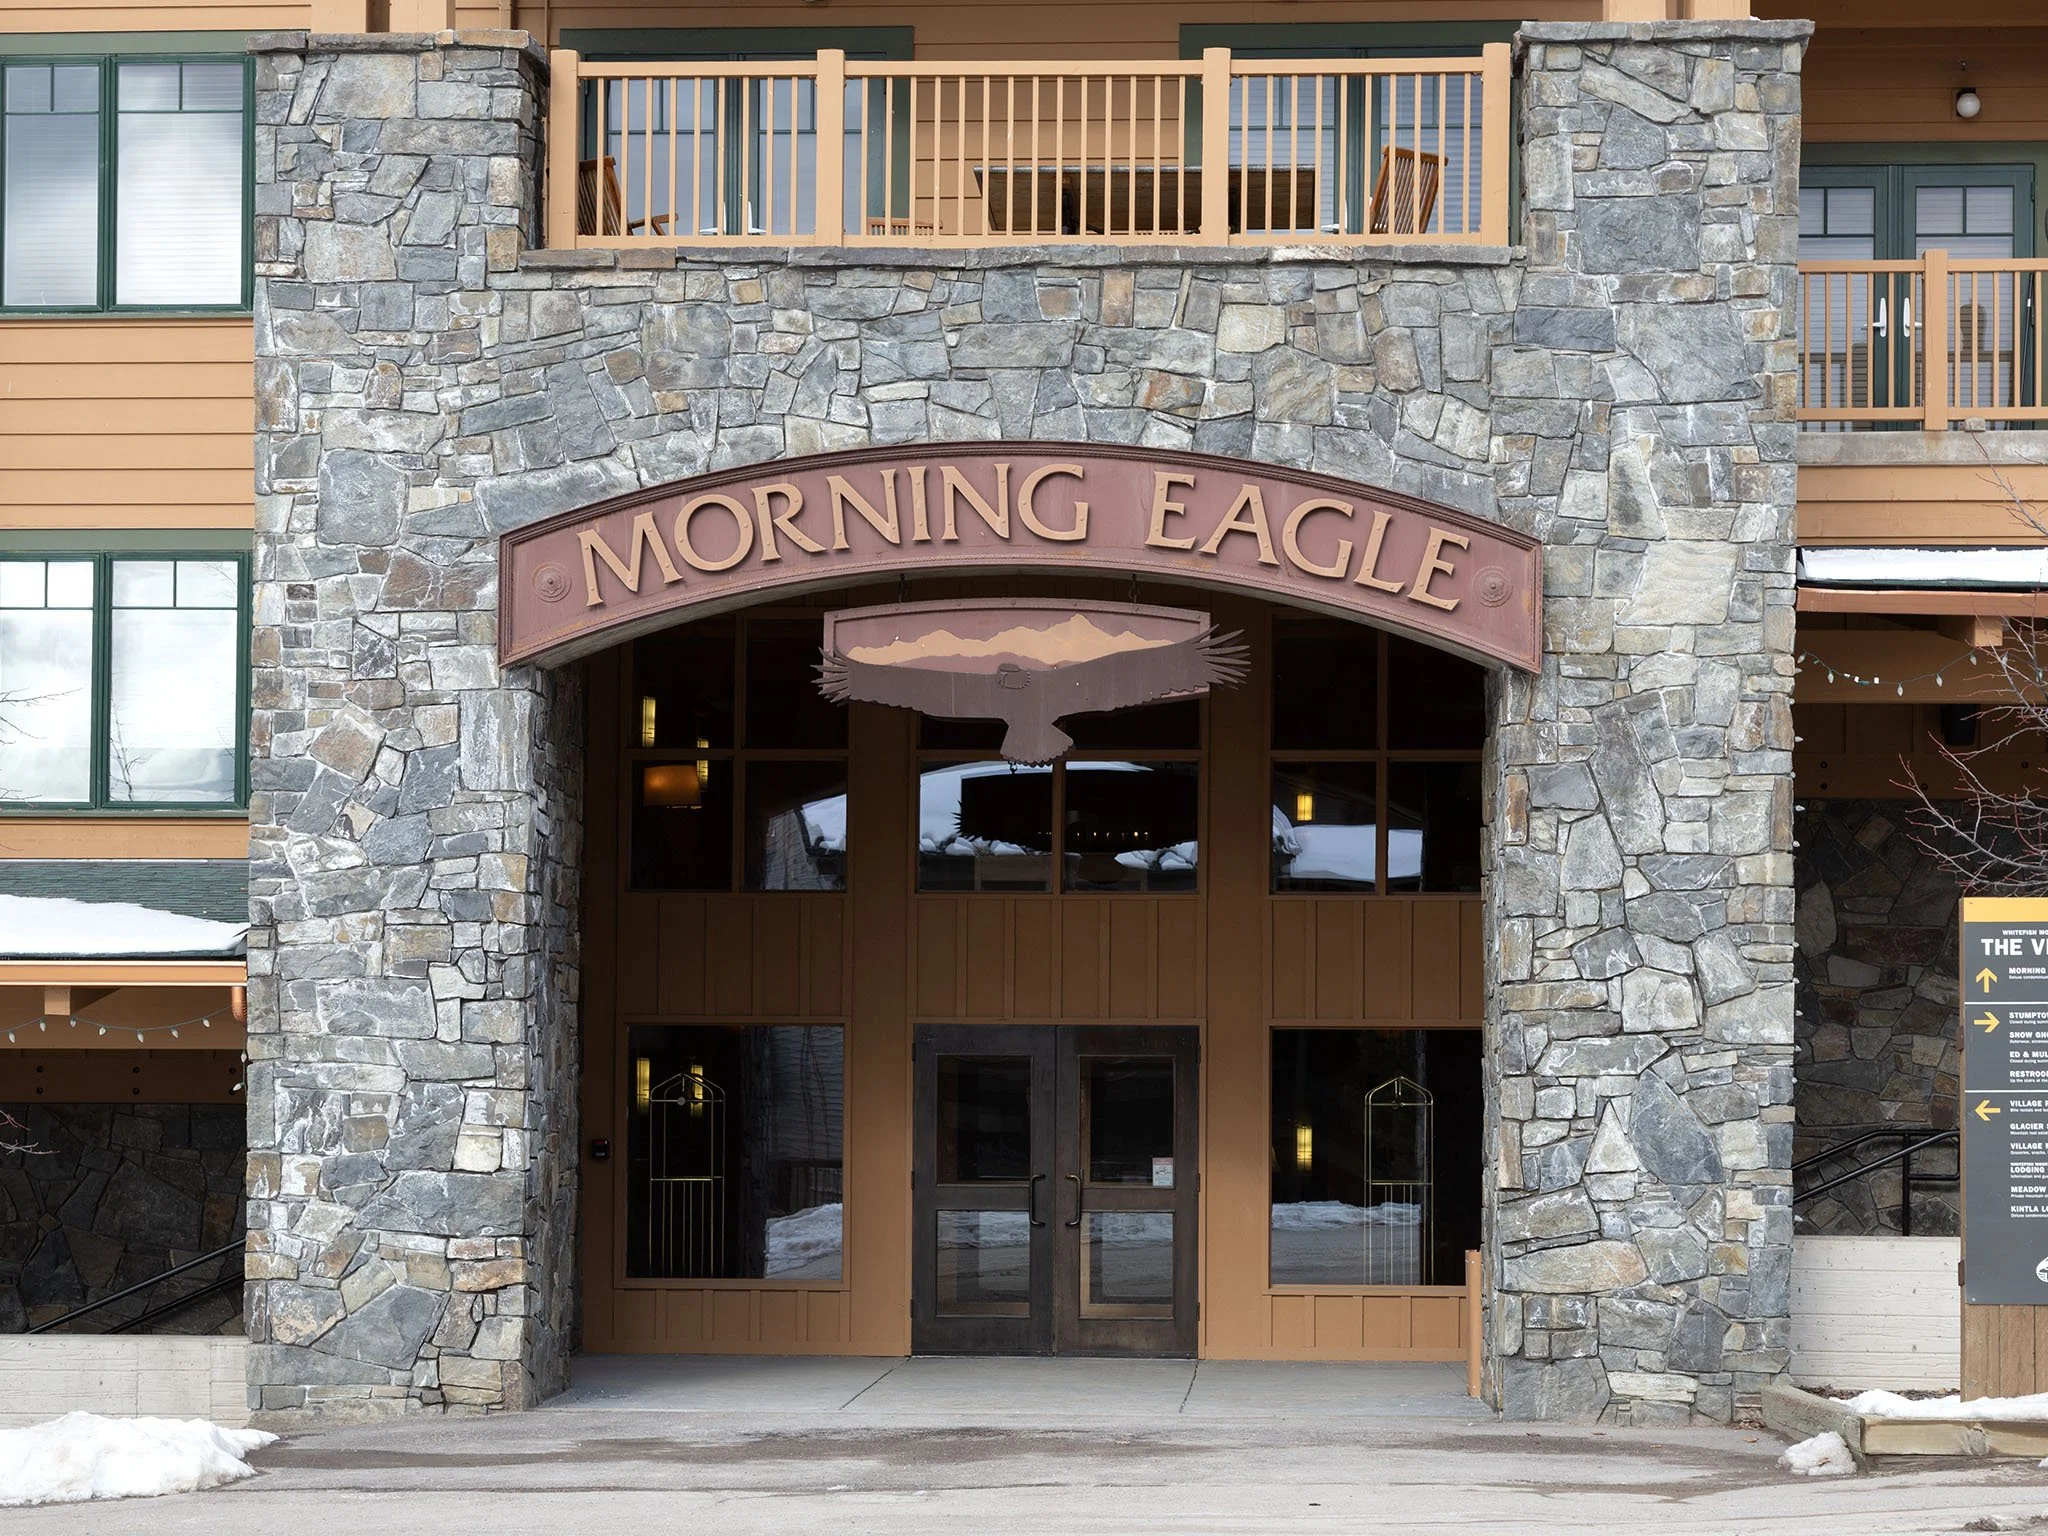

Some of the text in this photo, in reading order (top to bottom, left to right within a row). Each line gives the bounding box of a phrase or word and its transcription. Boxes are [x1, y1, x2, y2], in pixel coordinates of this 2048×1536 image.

[577, 463, 1472, 611] MORNING EAGLE
[1981, 938, 2023, 956] THE
[2009, 1070, 2048, 1078] RESTROO
